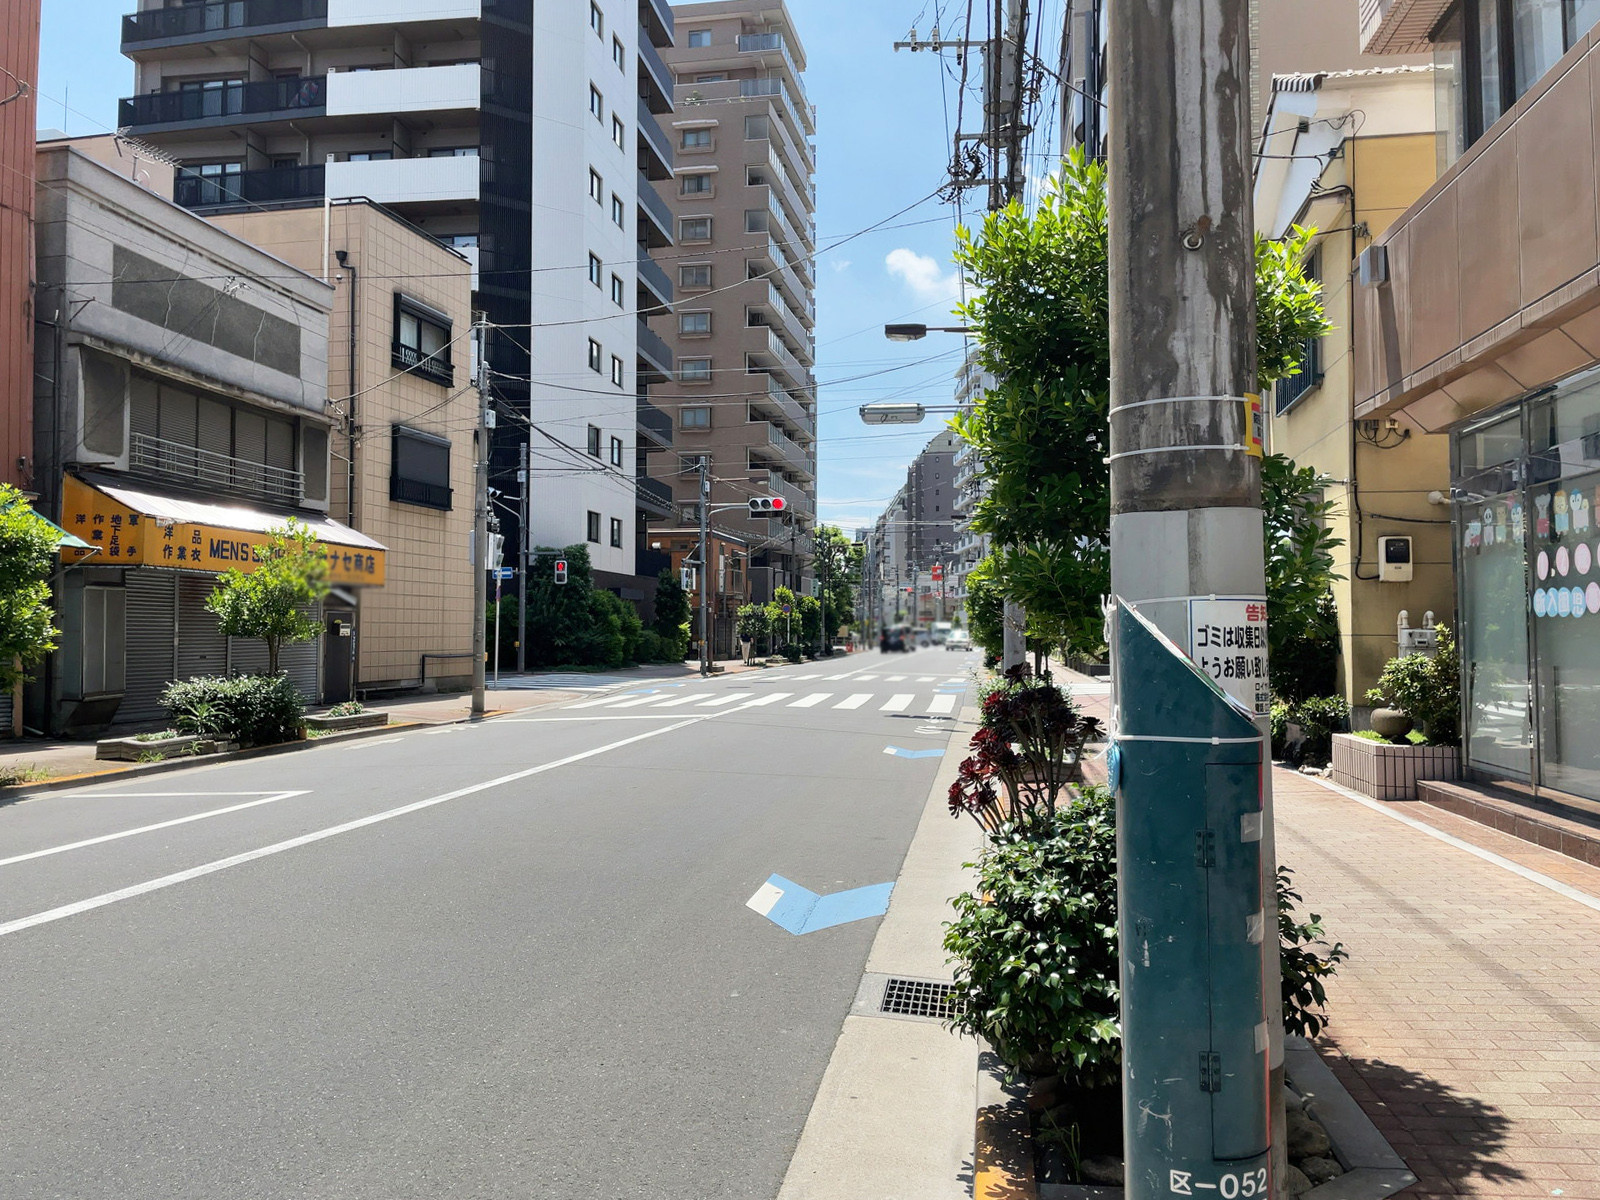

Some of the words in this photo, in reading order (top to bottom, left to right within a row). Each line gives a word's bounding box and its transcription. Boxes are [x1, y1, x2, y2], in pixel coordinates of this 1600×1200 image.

[109, 514, 122, 556] 地下足袋
[127, 514, 139, 557] 軍手
[209, 538, 249, 562] MEN'S
[163, 544, 201, 562] 作業衣
